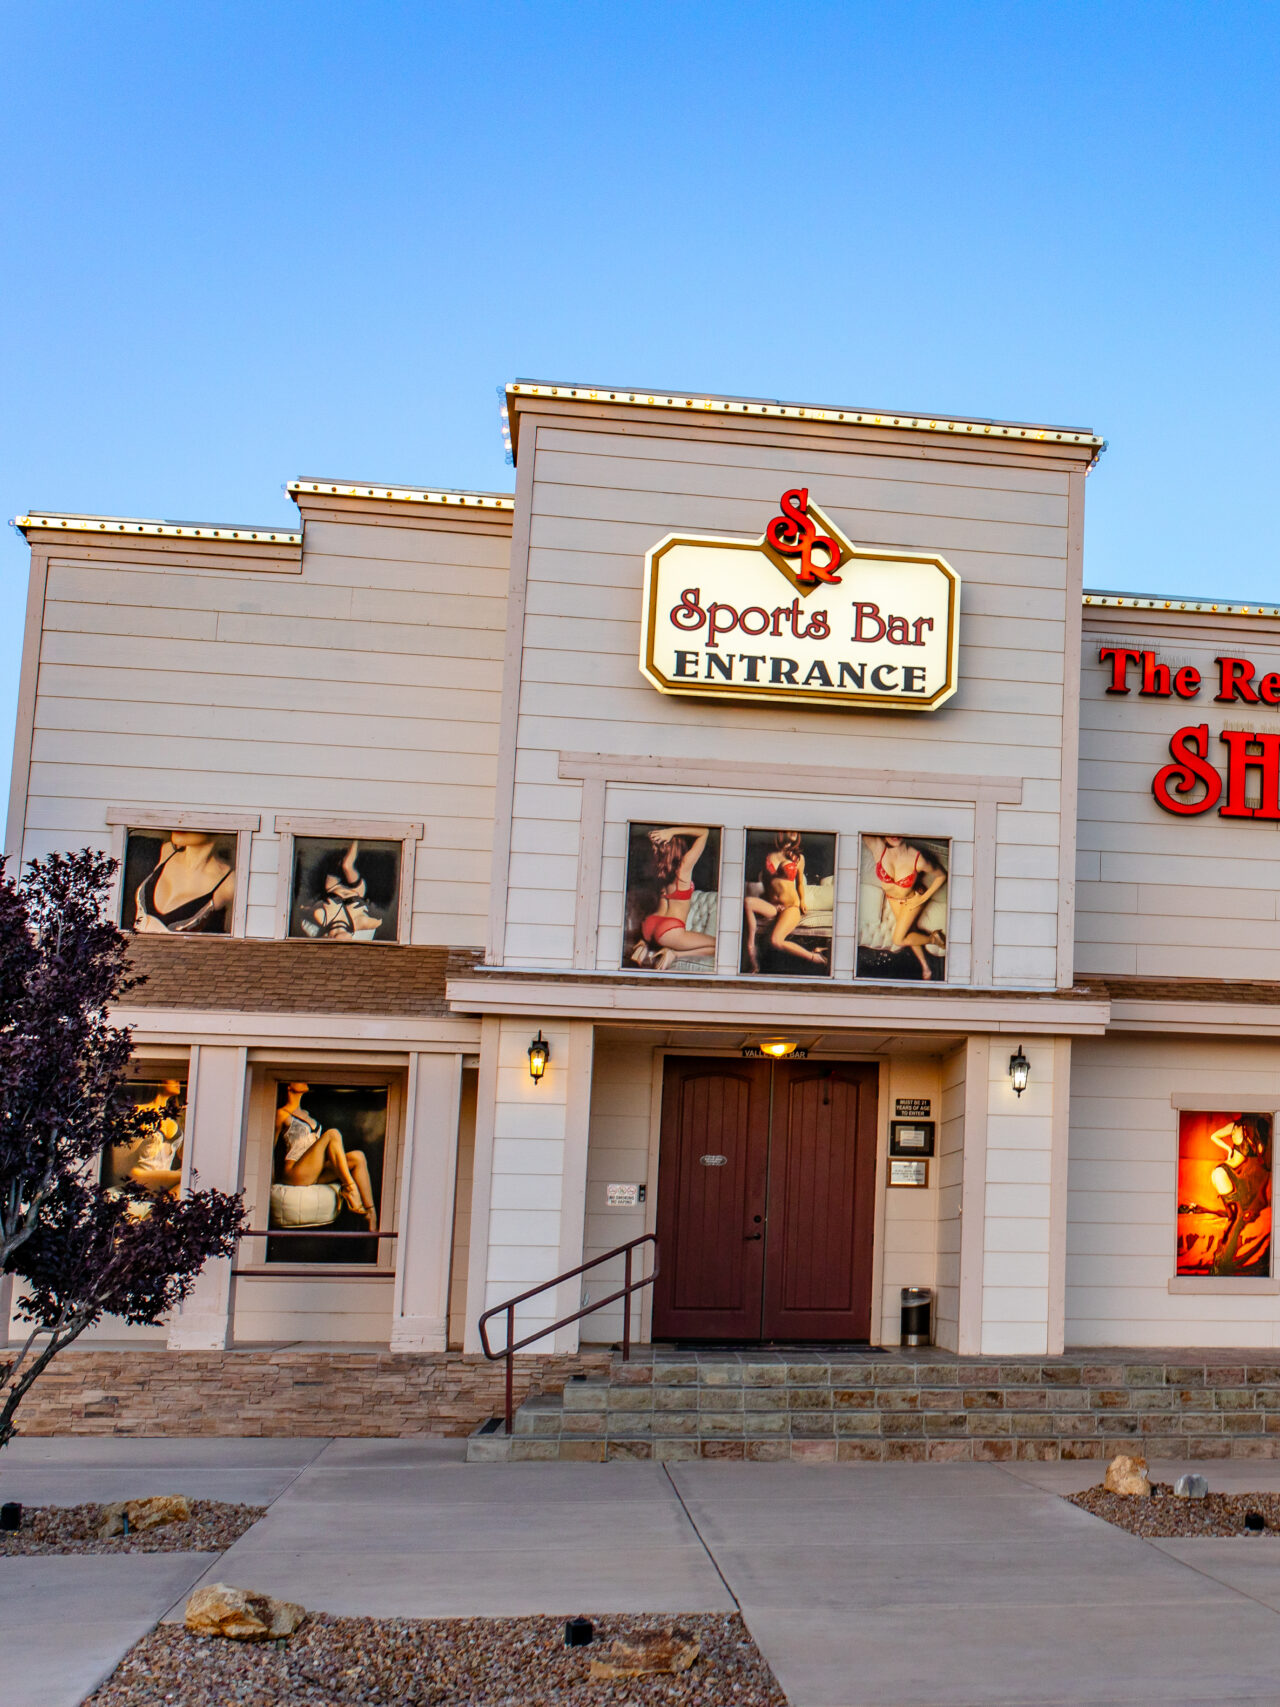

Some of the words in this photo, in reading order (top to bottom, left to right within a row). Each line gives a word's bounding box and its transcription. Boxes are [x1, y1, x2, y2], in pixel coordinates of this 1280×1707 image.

[670, 588, 831, 648] Sports
[851, 601, 934, 646] Bar
[673, 650, 927, 693] ENTRANCE
[1099, 647, 1201, 699] The
[790, 1051, 806, 1059] BAR
